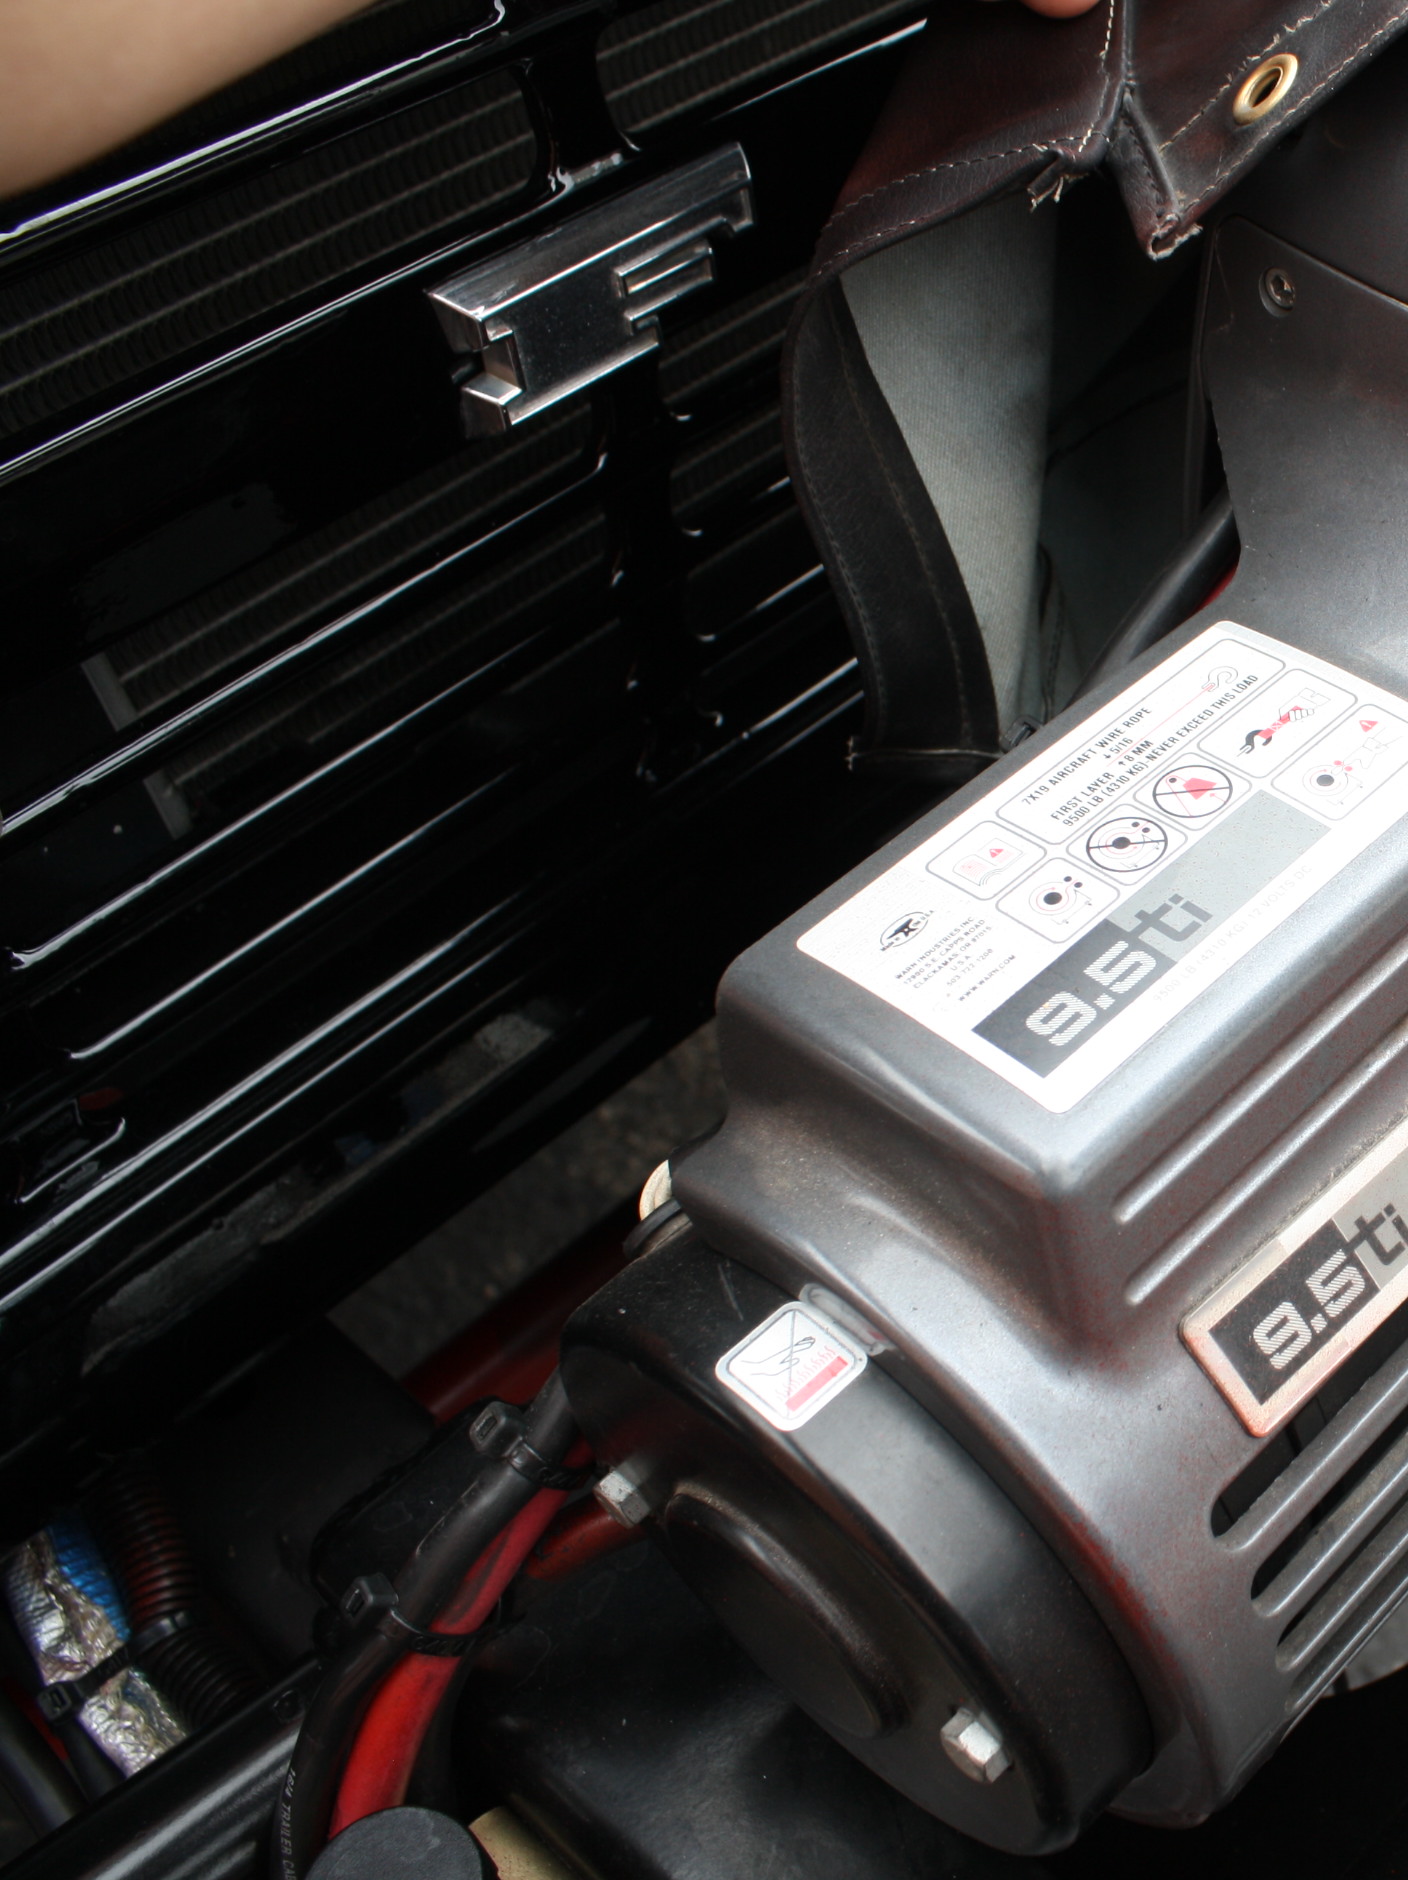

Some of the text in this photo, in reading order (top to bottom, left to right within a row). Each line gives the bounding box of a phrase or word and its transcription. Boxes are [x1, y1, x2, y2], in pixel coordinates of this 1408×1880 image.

[1023, 708, 1150, 804] 7X19 AIRCRAFT WIRE ROPE
[1063, 806, 1090, 826] 9500
[1087, 796, 1103, 806] LB
[1101, 775, 1129, 796] (4310
[1176, 710, 1214, 737] EXCEED
[1211, 693, 1235, 709] THIS
[1232, 676, 1258, 693] LOAD
[1110, 738, 1133, 753] 5/16
[1051, 797, 1082, 820] FIRST
[1081, 773, 1114, 796] LAYER
[1132, 741, 1153, 755] MM
[1261, 880, 1295, 907] VOLTS
[896, 963, 917, 979] WARN
[917, 929, 960, 962] INDUSTRIES
[940, 937, 964, 956] CAPPS
[964, 920, 984, 936] ROAD
[1025, 892, 1214, 1047] 9.5ti
[281, 1803, 291, 1854] TRAILER
